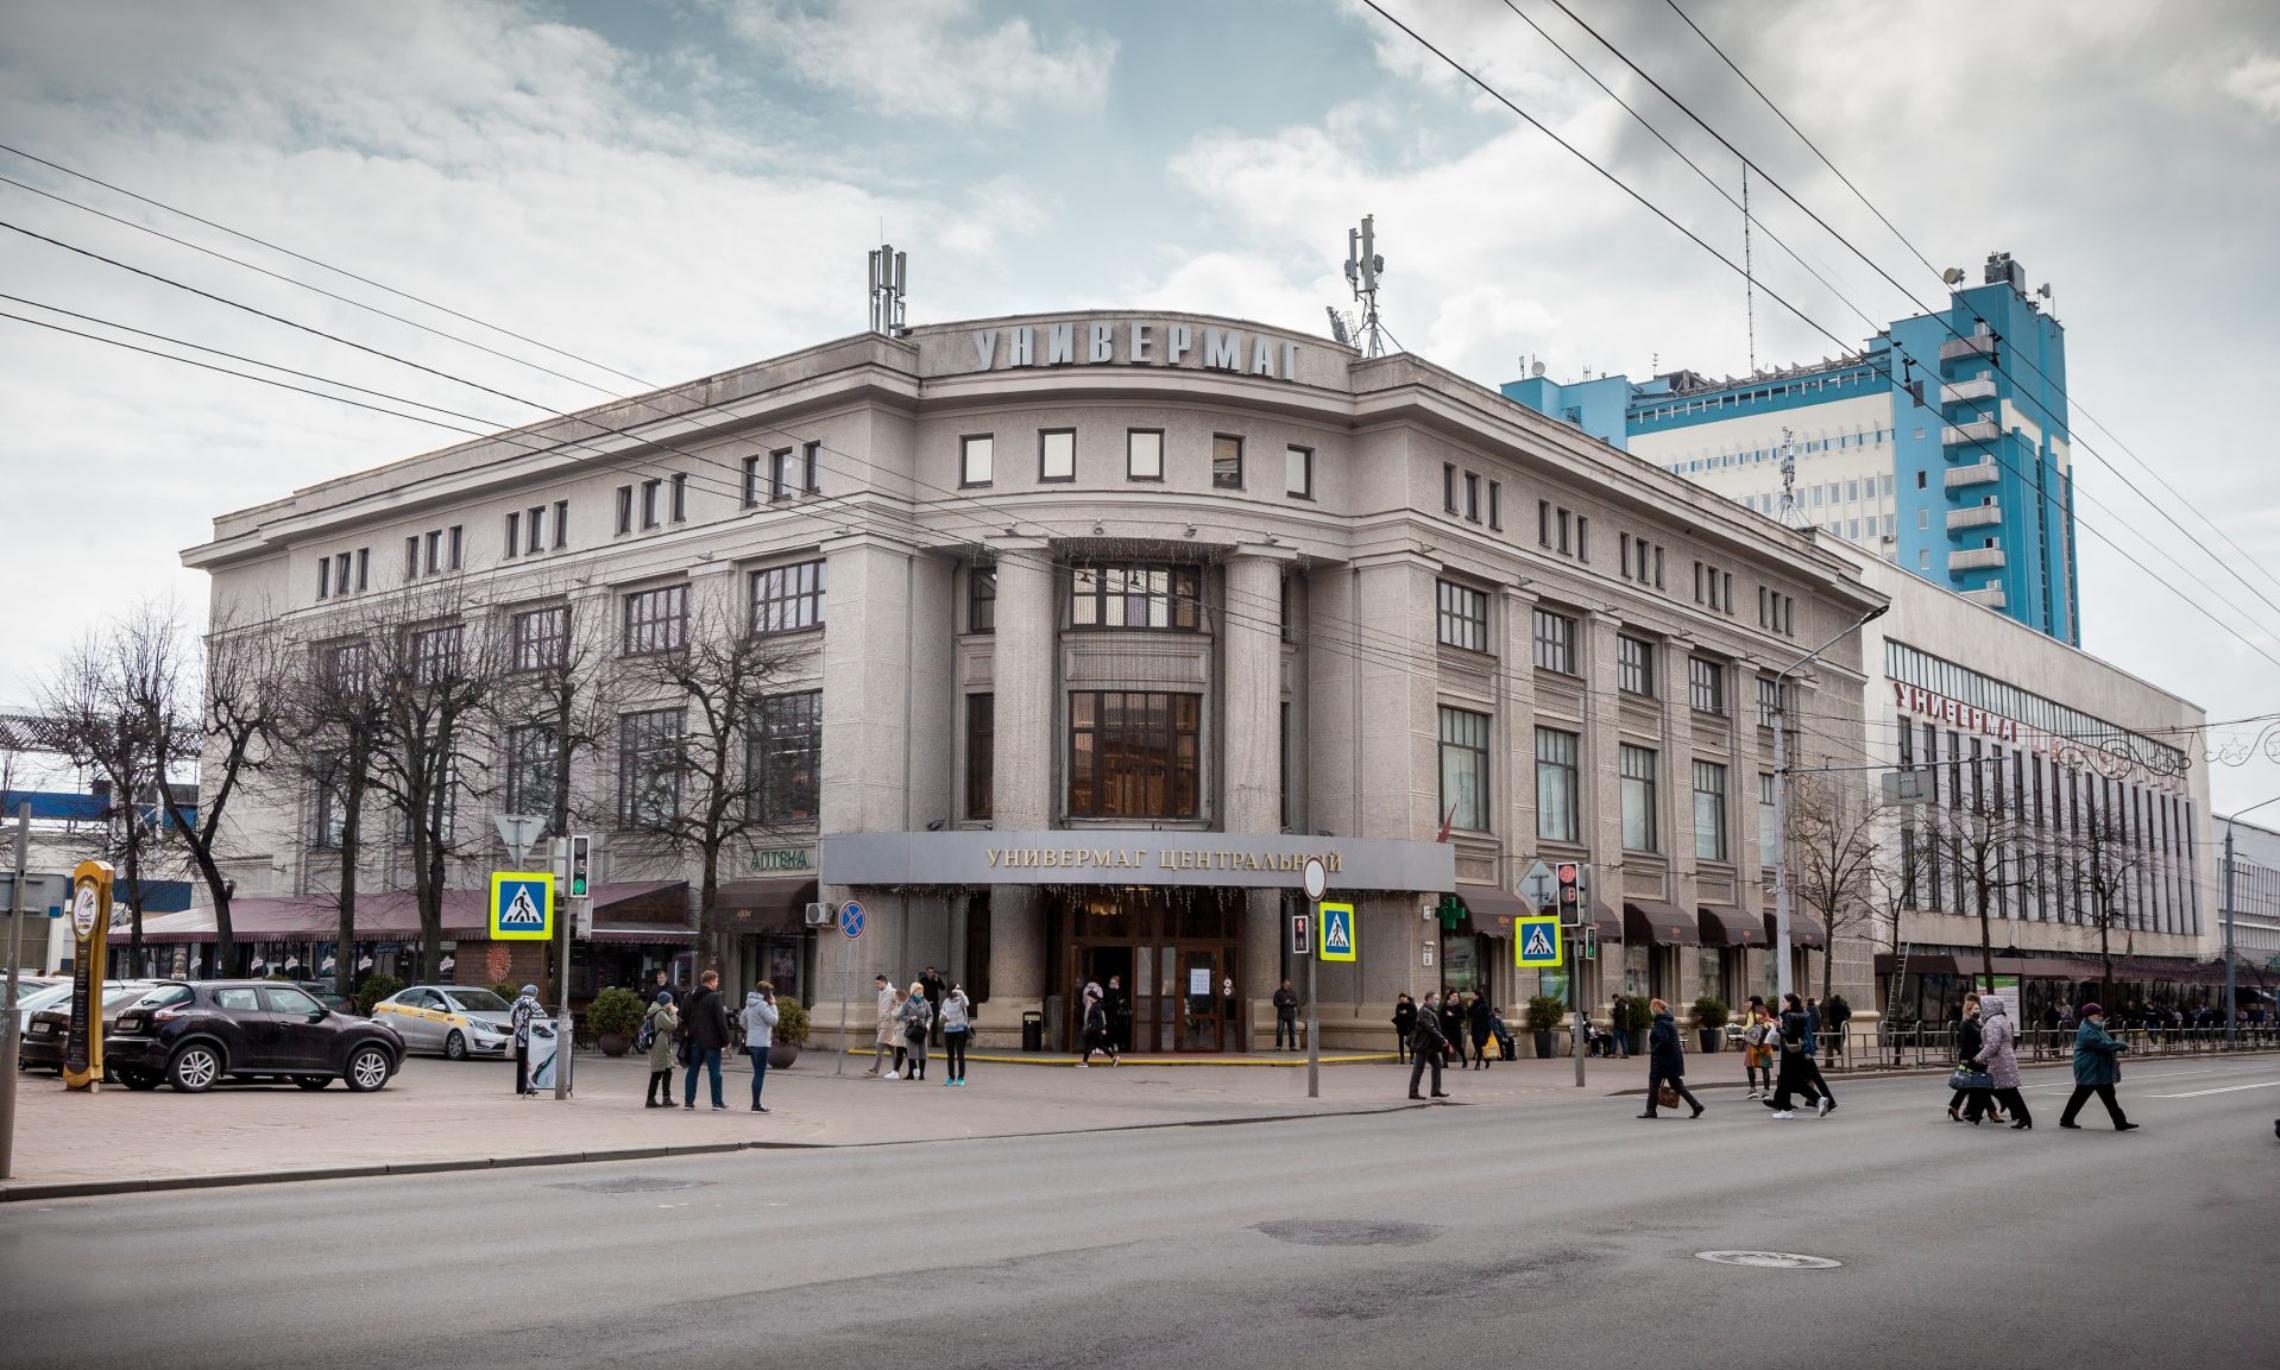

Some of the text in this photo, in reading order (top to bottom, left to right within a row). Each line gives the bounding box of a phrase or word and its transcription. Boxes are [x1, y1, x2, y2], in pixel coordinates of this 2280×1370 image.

[974, 321, 1300, 380] УНИВЕРМАГ
[750, 849, 807, 870] АПТЕКА
[986, 848, 1147, 869] УНИВЕРМАГ
